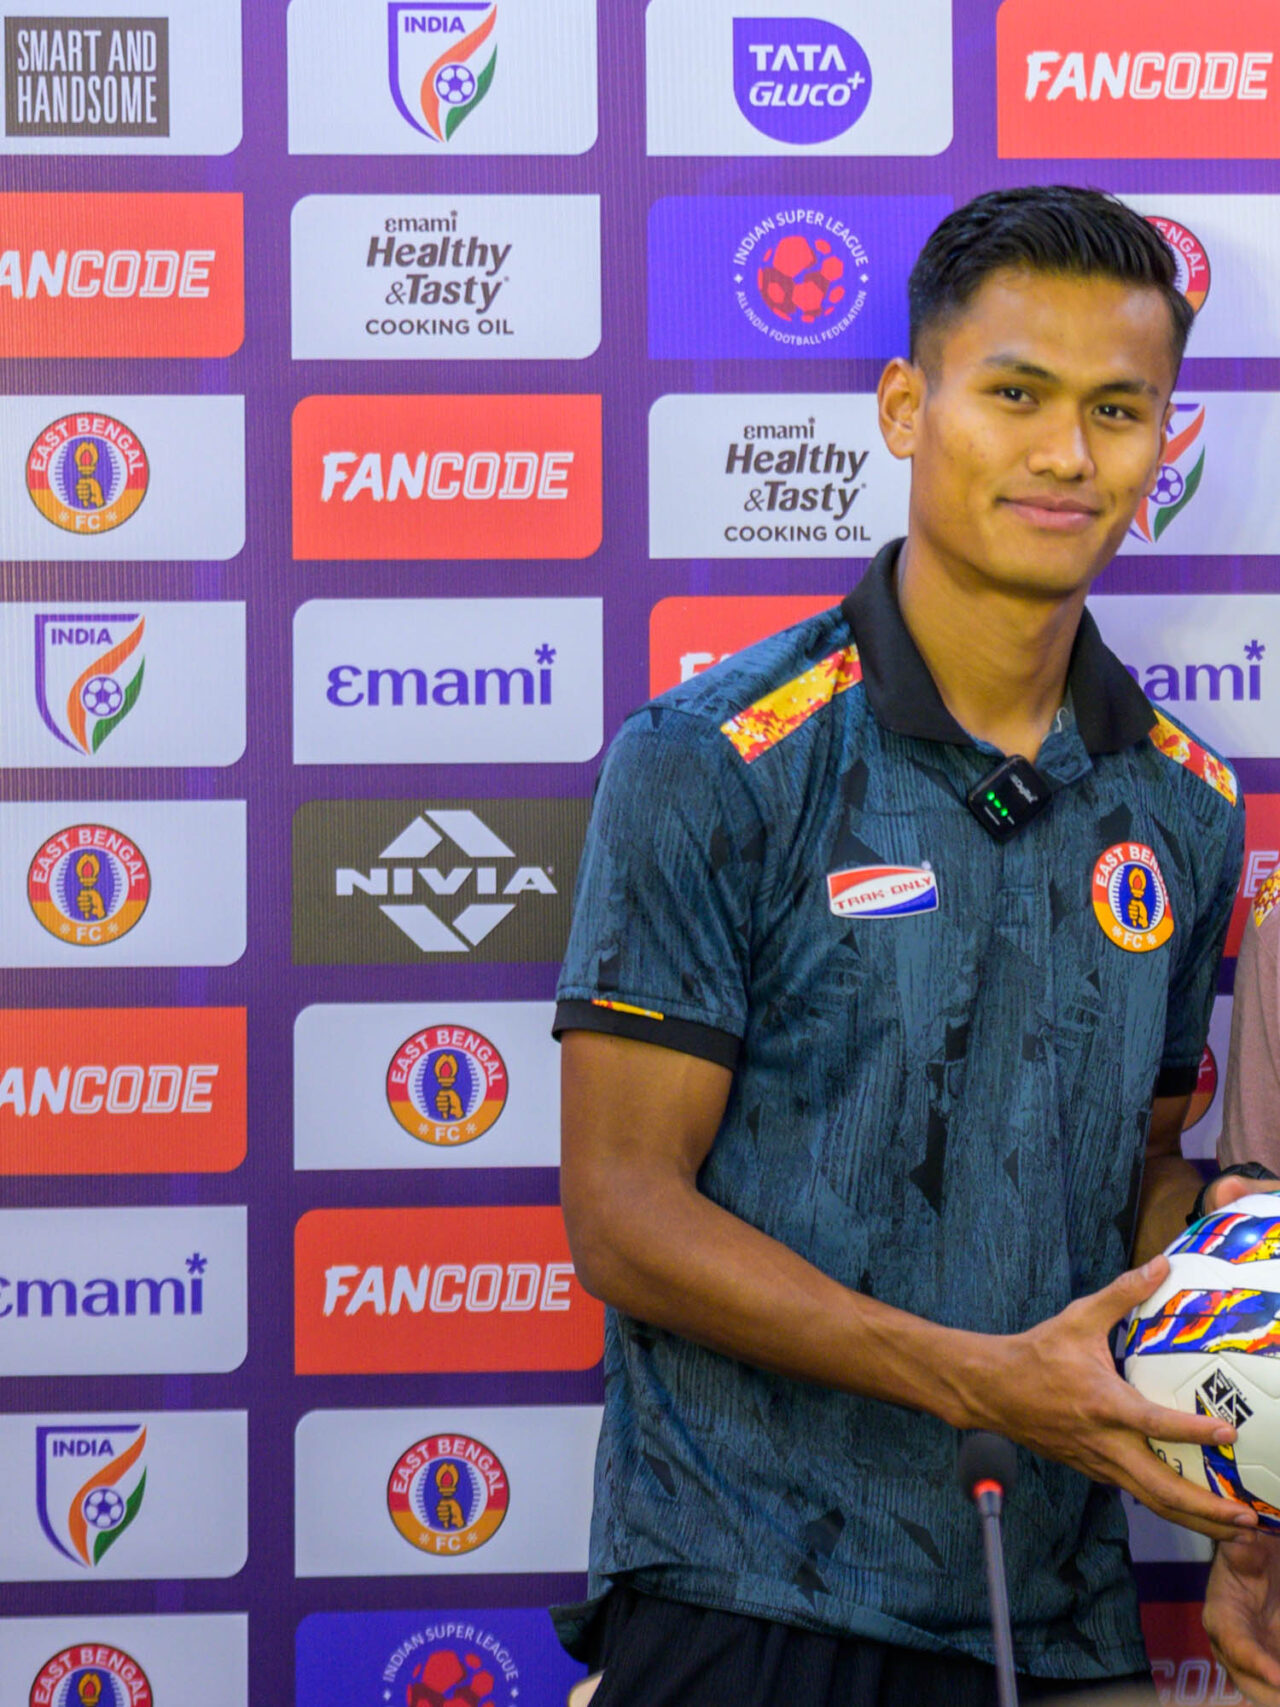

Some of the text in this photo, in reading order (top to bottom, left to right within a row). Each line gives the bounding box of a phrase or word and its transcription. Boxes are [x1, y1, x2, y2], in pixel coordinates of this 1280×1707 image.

[404, 16, 466, 33] INDIA
[18, 30, 157, 71] SMART AND
[748, 44, 847, 71] TATA
[1026, 51, 1273, 101] FANCODE
[18, 76, 157, 124] HANDSOME
[366, 236, 512, 277] Healthy
[733, 209, 869, 267] INDIAN SUPER LEAGUE
[1155, 220, 1206, 278] ENGAL
[0, 250, 216, 300] ANCODE
[366, 319, 514, 335] COOKING OIL
[736, 290, 867, 346] ALL INDIA FOOTBALL FEDERATION
[31, 417, 144, 476] EAST BENGAL
[725, 443, 870, 483] Healthy
[320, 451, 574, 502] FANCODE
[75, 514, 101, 530] FC
[724, 525, 871, 542] COOKING OIL
[51, 628, 113, 646] INDIA
[1124, 639, 1266, 701] ami
[33, 829, 145, 888] EAST BENGAL
[1096, 847, 1124, 888] EAST
[336, 866, 558, 896] NIVIA
[76, 926, 102, 942] FC
[1123, 931, 1143, 949] FC
[391, 1030, 503, 1088] EAST BENGAL
[0, 1065, 219, 1117] ANCODE
[435, 1127, 460, 1142] FC
[323, 1263, 574, 1316] FANCODE
[53, 1440, 114, 1457] INDIA
[392, 1439, 505, 1497] EAST BENGAL
[436, 1535, 461, 1551] FC
[382, 1622, 519, 1683] INDIAN SUPER LEAGUE
[34, 1647, 147, 1706] EAST BENGAL
